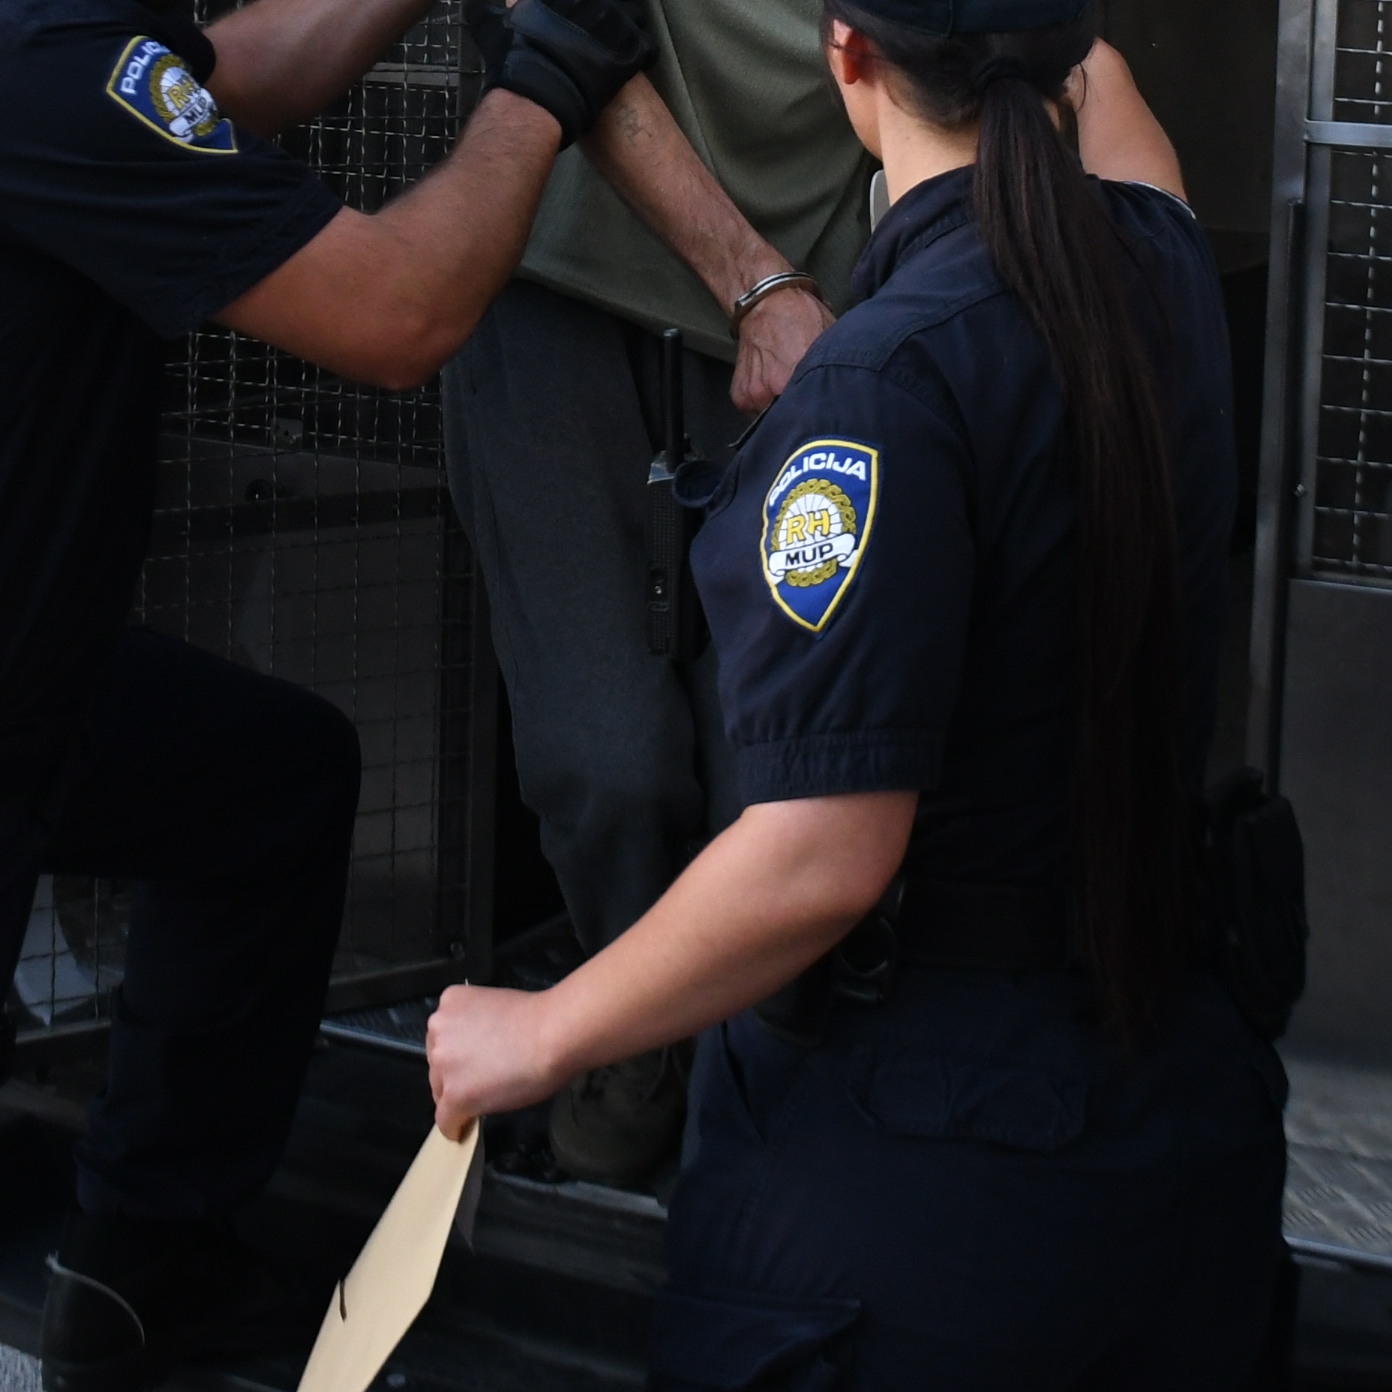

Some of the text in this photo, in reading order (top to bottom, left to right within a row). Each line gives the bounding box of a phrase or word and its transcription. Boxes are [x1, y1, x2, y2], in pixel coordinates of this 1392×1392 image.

[121, 41, 170, 94] POLIC
[184, 96, 207, 125] MUP
[770, 453, 866, 506] POLICIJA
[786, 510, 831, 544] RH
[786, 544, 833, 565] MUP
